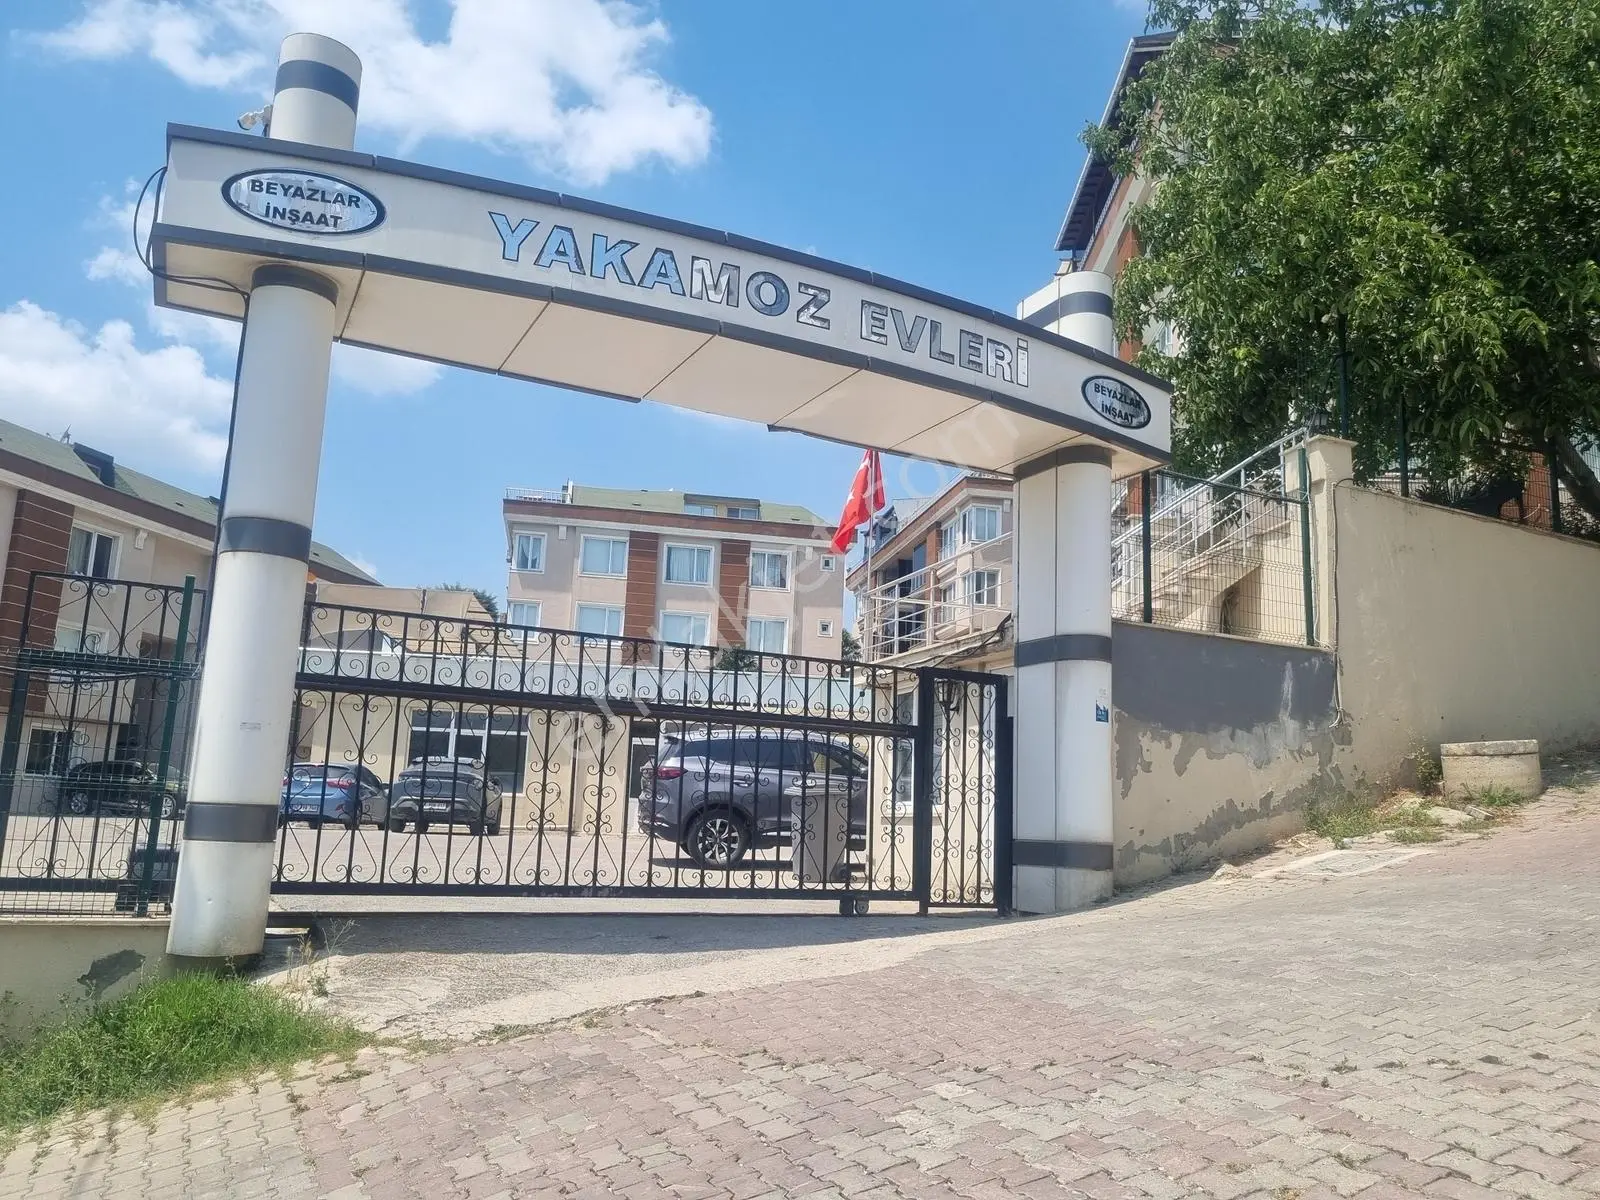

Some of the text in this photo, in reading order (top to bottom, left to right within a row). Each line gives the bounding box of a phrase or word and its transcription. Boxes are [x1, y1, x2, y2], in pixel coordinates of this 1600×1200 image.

[250, 178, 361, 209] BEYAZLAR
[264, 202, 343, 229] İNŞAAT
[488, 211, 1029, 388] YAKAMOZ EVLERİ
[1093, 382, 1142, 410] BEYAZLAR
[1100, 400, 1137, 426] İNŞAAT
